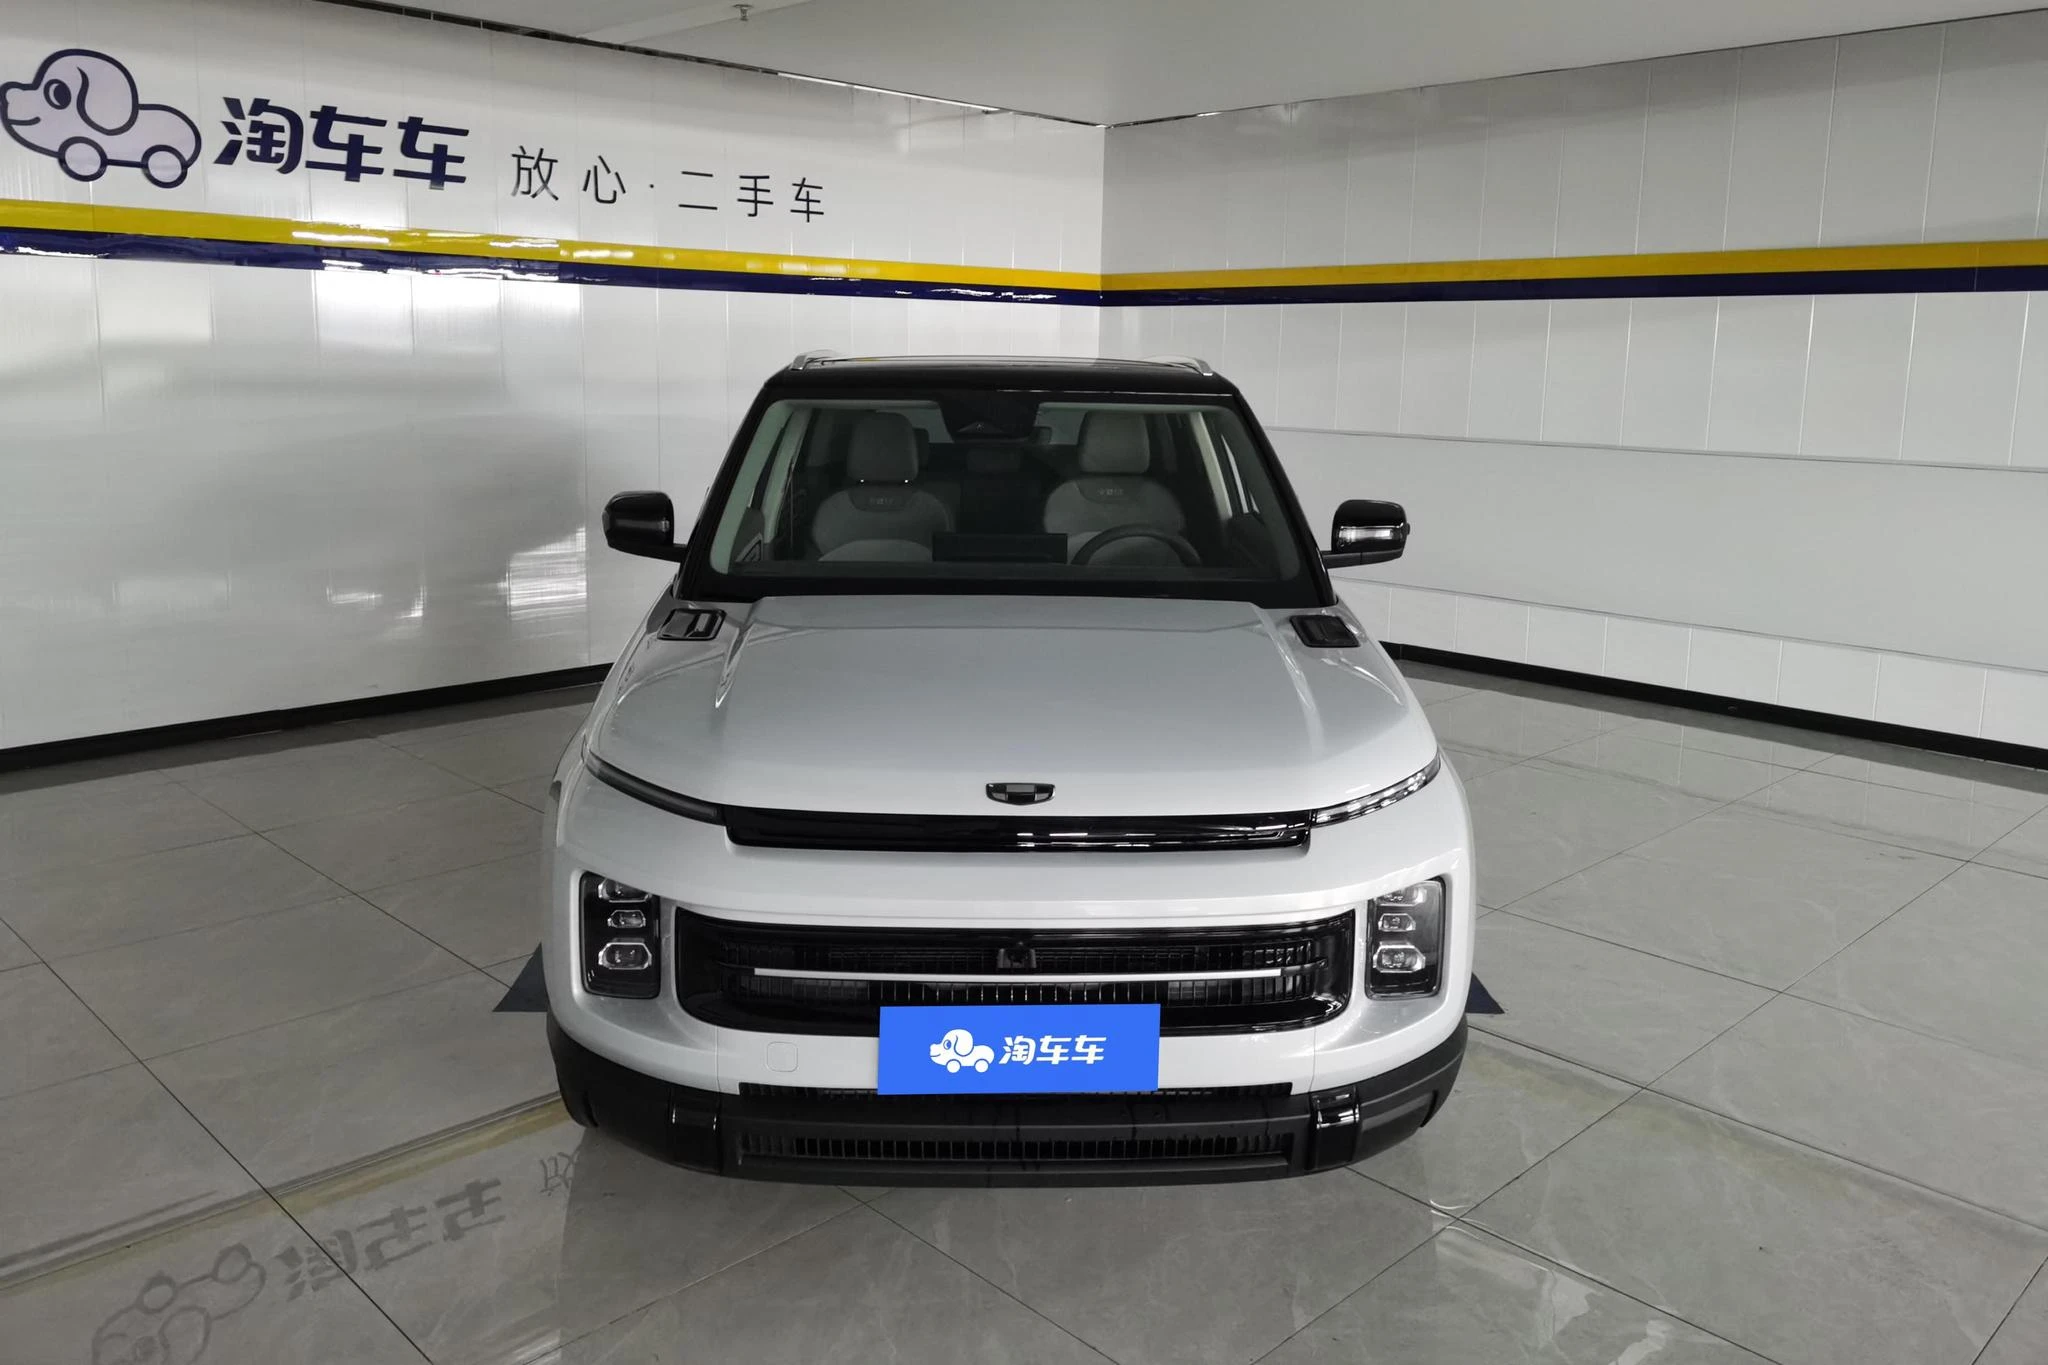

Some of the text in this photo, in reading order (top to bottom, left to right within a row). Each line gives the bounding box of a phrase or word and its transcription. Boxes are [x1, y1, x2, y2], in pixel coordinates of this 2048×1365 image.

[214, 97, 470, 190] 淘车车
[511, 145, 825, 223] 放心·二手车
